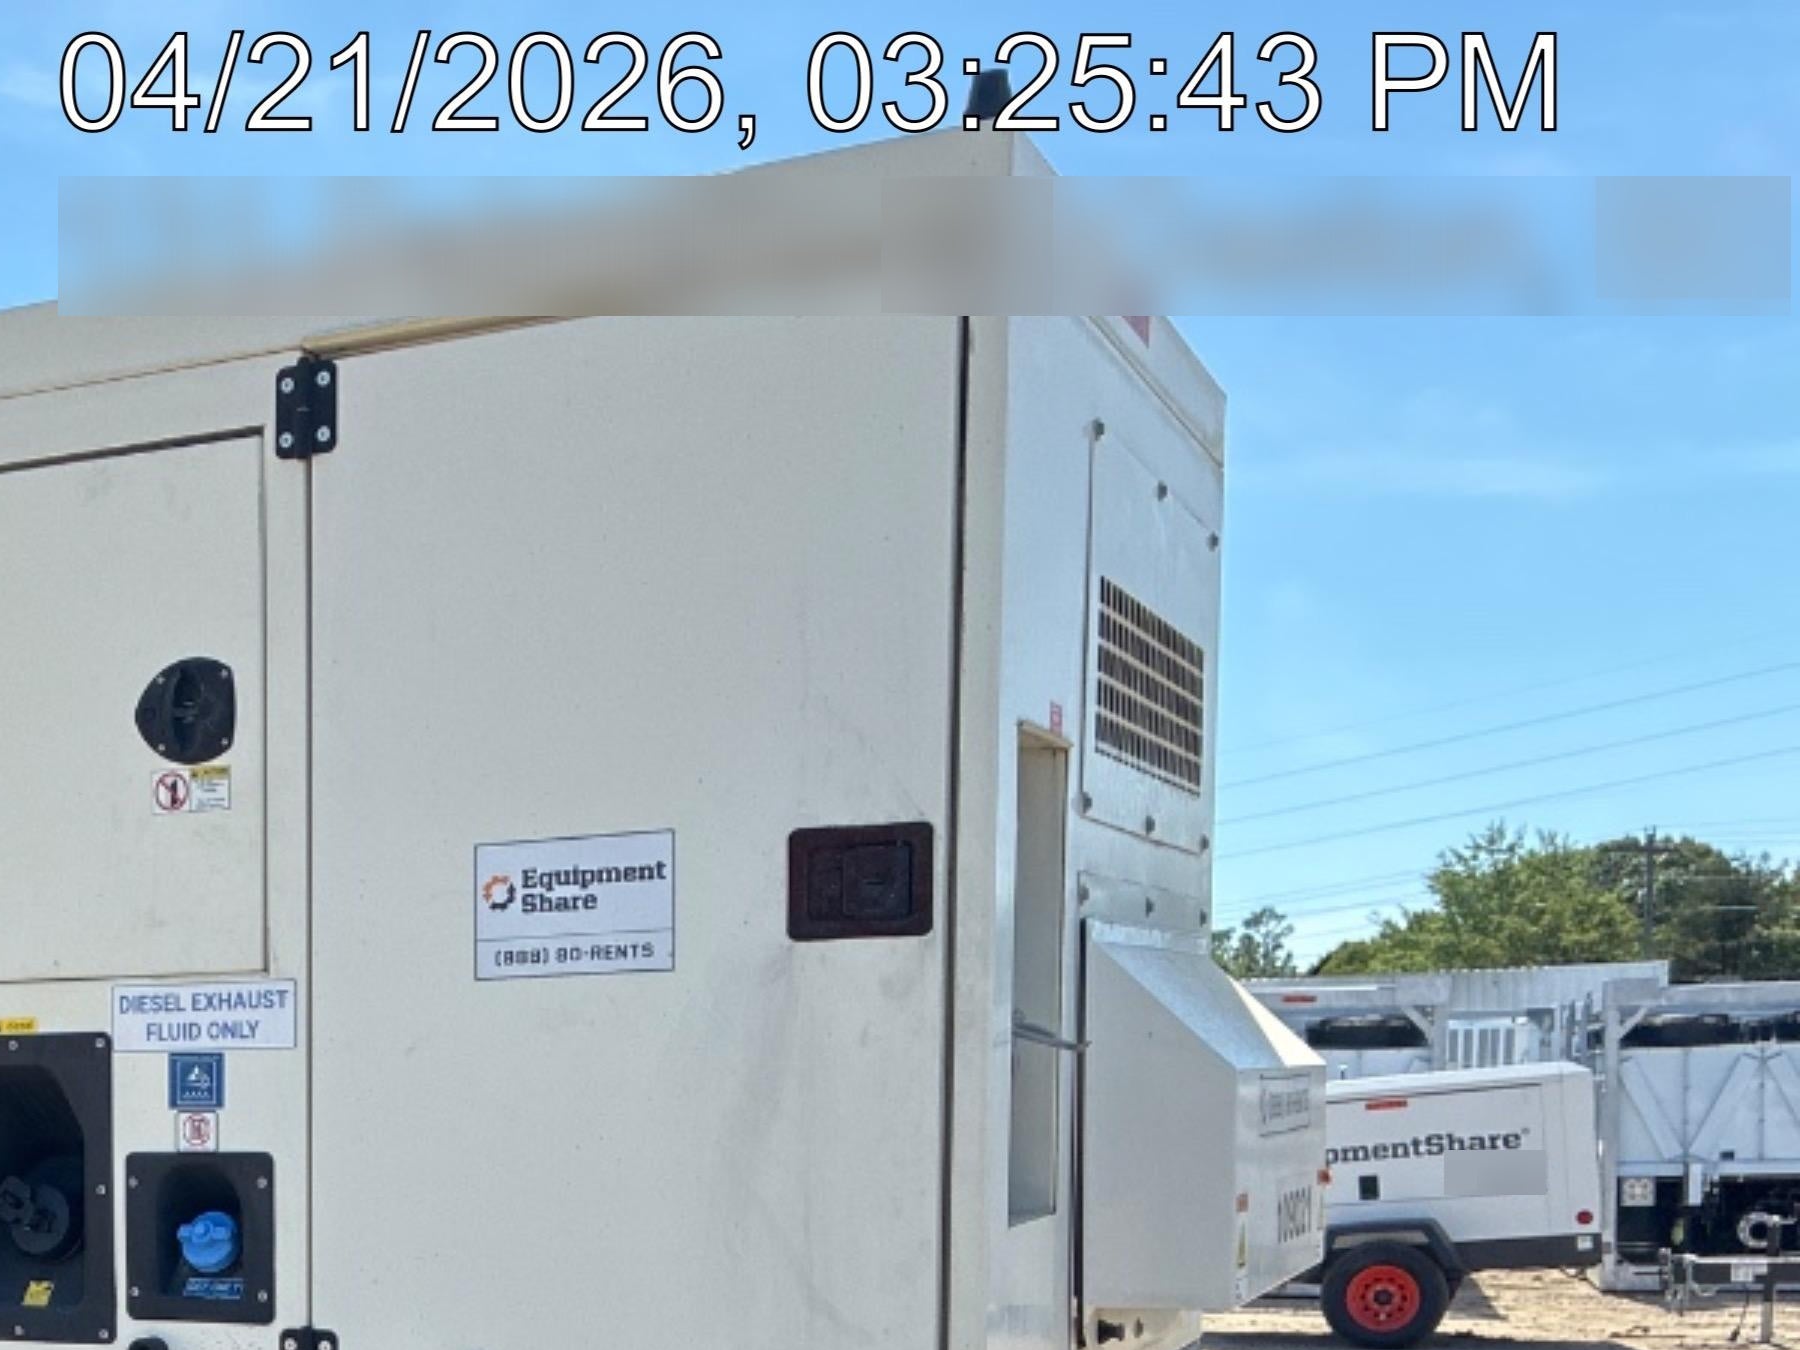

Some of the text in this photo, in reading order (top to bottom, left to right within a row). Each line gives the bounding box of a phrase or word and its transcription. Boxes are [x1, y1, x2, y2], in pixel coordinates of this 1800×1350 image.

[521, 860, 667, 890] Equipment
[521, 892, 599, 914] Share
[119, 989, 289, 1015] DIESEL EXHAUST
[146, 1020, 260, 1042] FLUID ONLY
